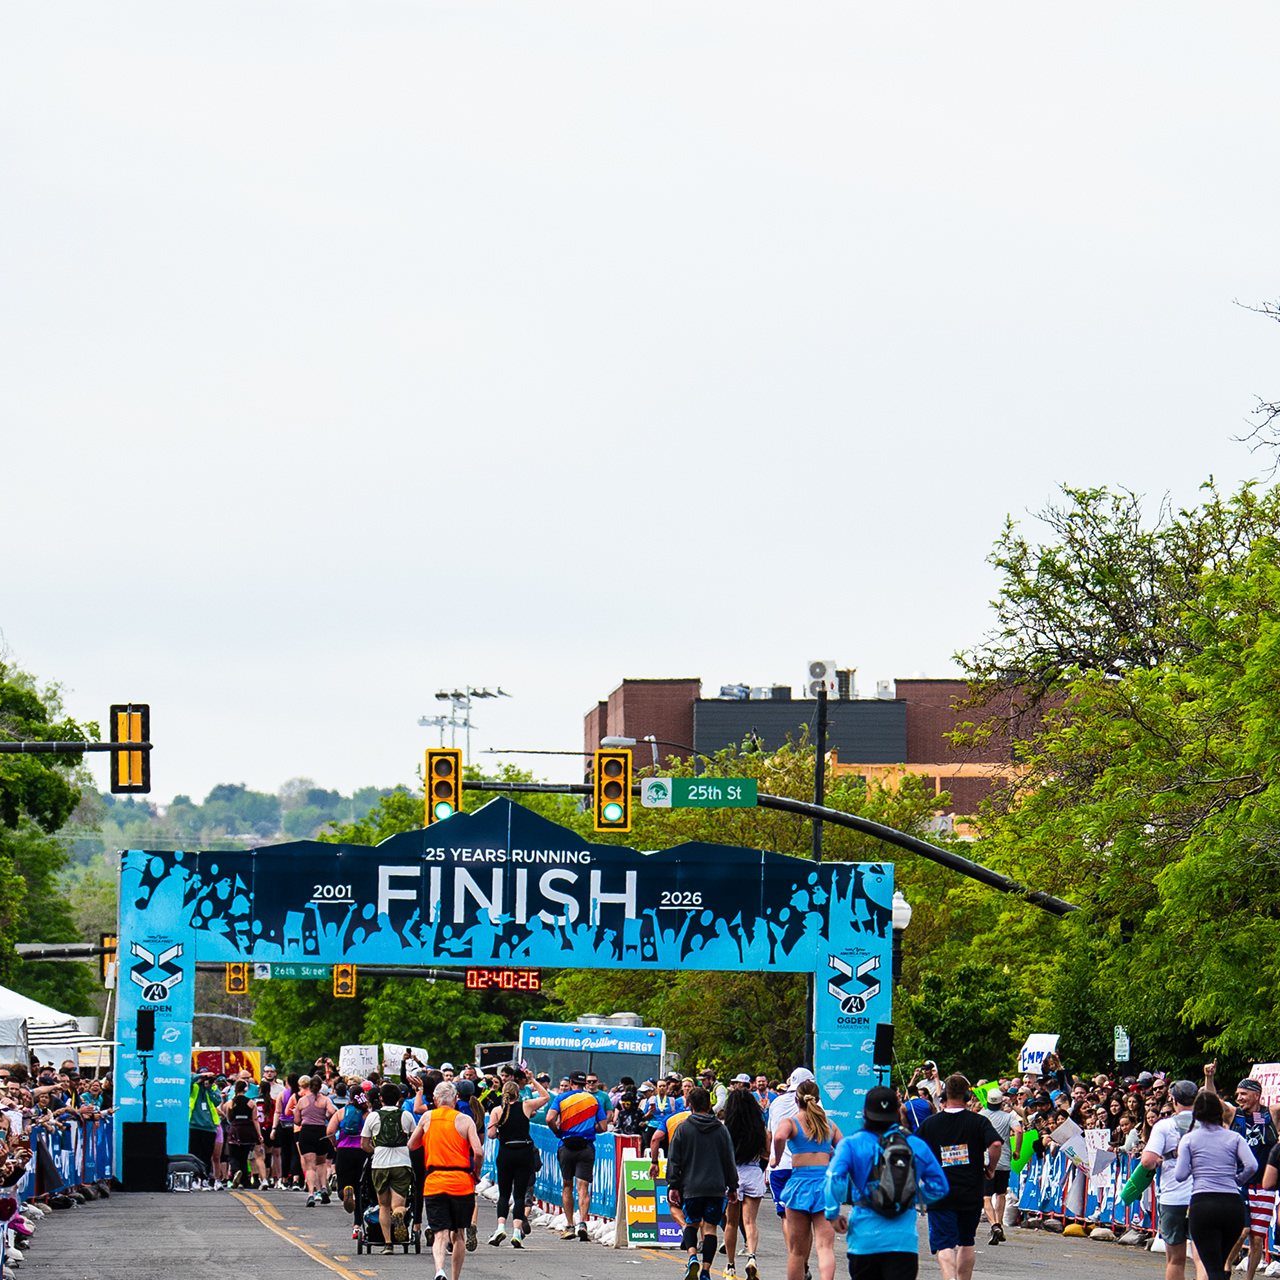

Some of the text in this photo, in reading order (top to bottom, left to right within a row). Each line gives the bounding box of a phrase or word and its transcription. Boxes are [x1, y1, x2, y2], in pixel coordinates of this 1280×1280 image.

[688, 785, 741, 800] 25th St
[426, 847, 591, 865] 25 YEARS RUNNING
[313, 885, 352, 899] 2001
[377, 865, 638, 926] FINISH
[661, 891, 702, 905] 2026
[466, 970, 540, 989] 02:40:26
[837, 1016, 870, 1025] OGDEN
[529, 1036, 654, 1053] PROMOTING Positive ENERGY
[153, 1077, 186, 1085] GRANITE
[631, 1170, 650, 1180] 5K
[629, 1204, 655, 1213] HALF
